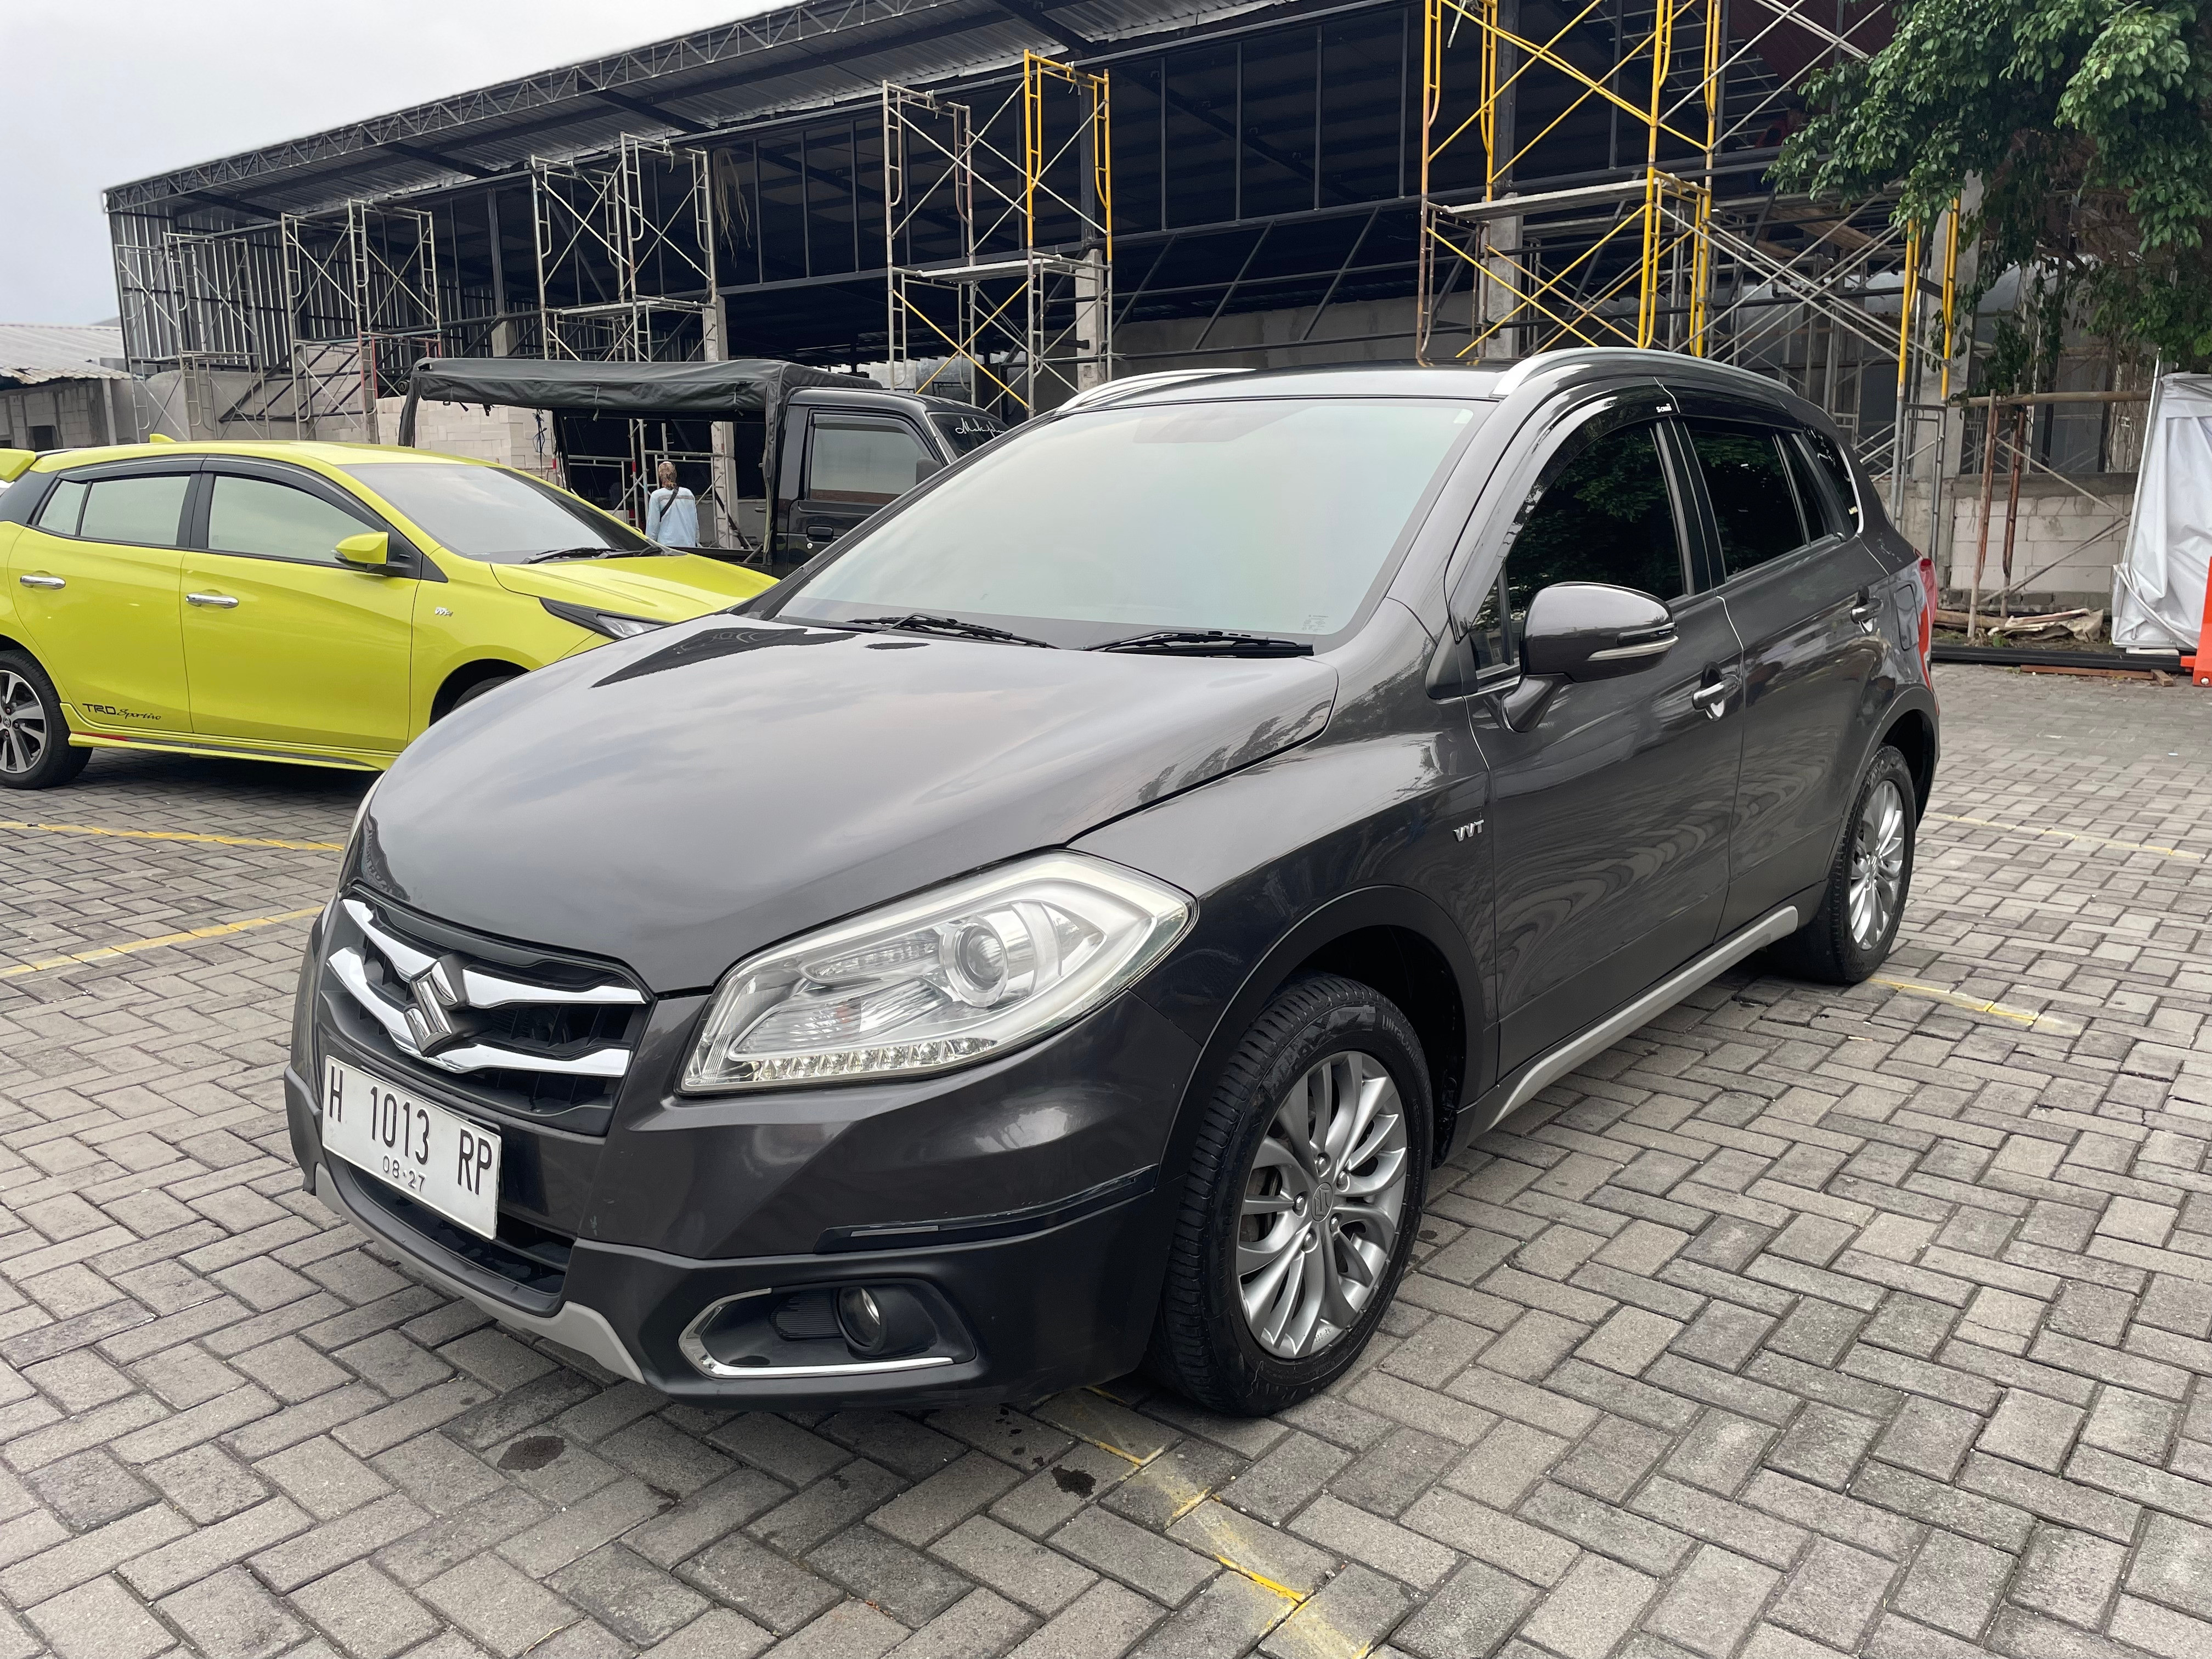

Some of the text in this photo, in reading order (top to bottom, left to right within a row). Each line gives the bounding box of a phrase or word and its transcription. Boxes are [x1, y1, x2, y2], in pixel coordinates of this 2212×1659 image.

[82, 703, 161, 720] TRD Sportivo
[1453, 819, 1485, 842] VVT
[329, 1064, 492, 1195] H 1013 RP
